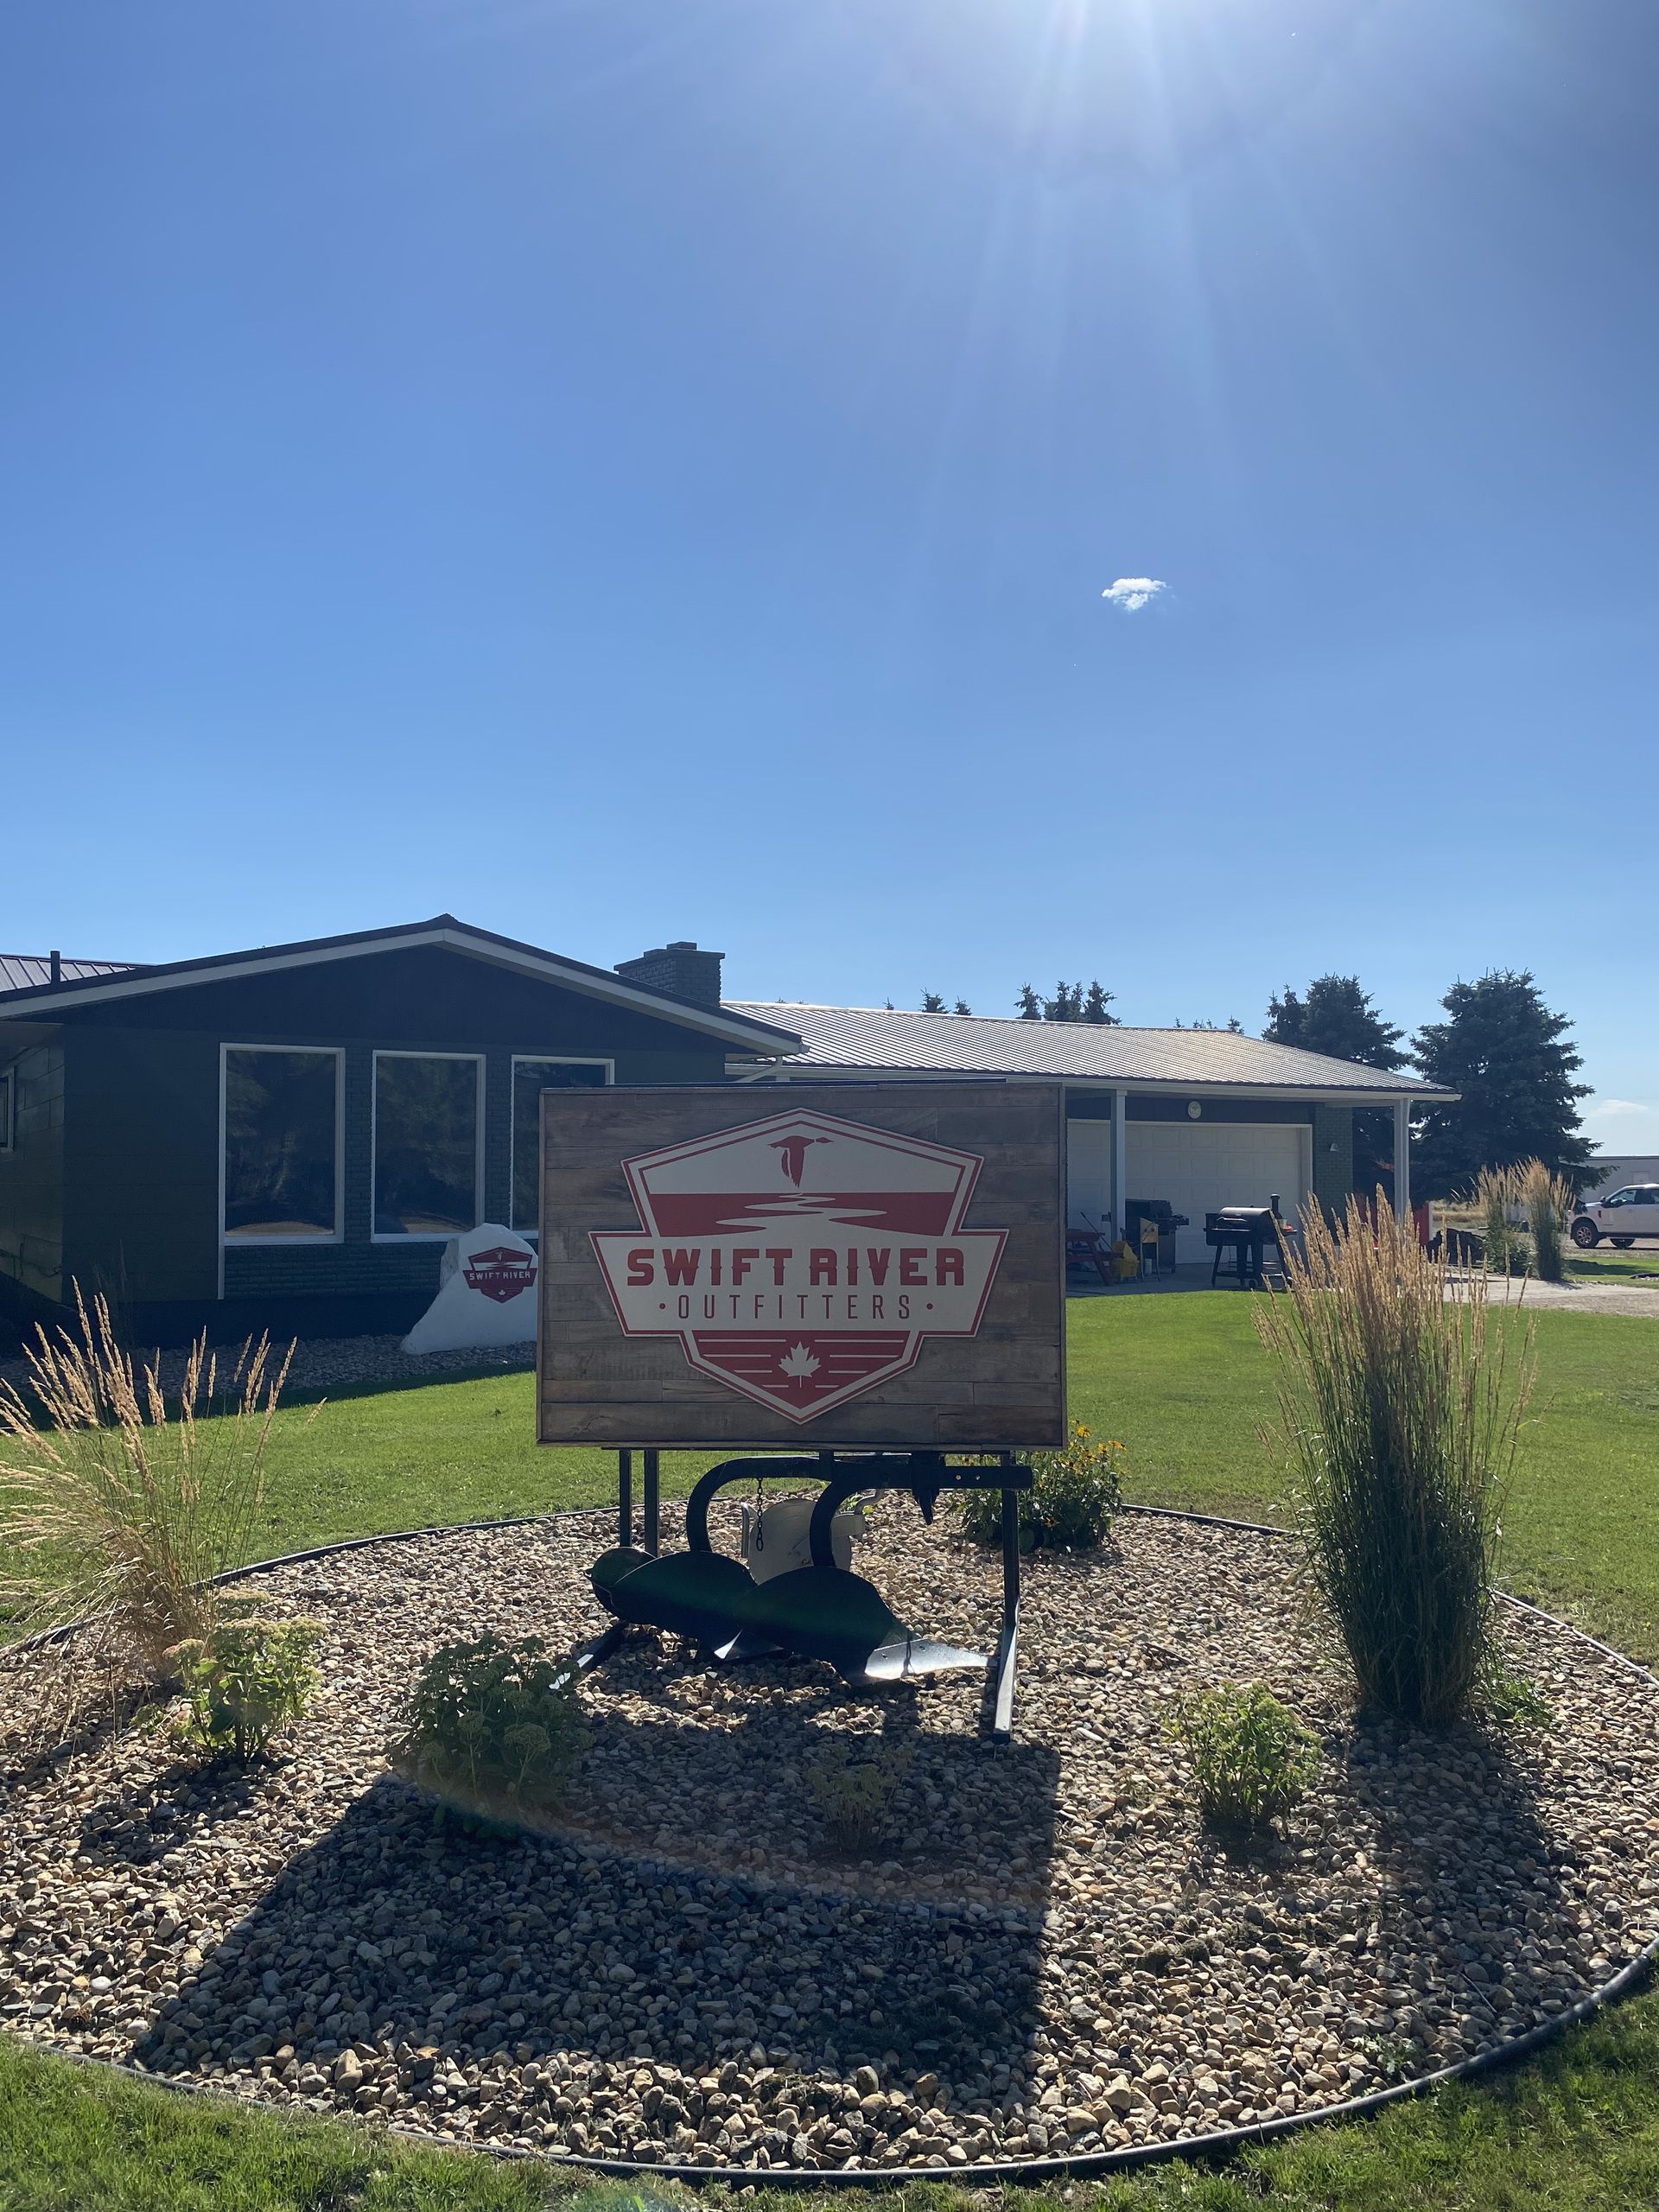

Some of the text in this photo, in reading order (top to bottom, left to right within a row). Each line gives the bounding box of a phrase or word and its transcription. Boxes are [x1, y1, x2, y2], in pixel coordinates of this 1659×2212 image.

[469, 1270, 531, 1281] SWIFT RIVER
[627, 1249, 964, 1286] SWIFT RIVER
[677, 1294, 911, 1319] OUTFITTERS
